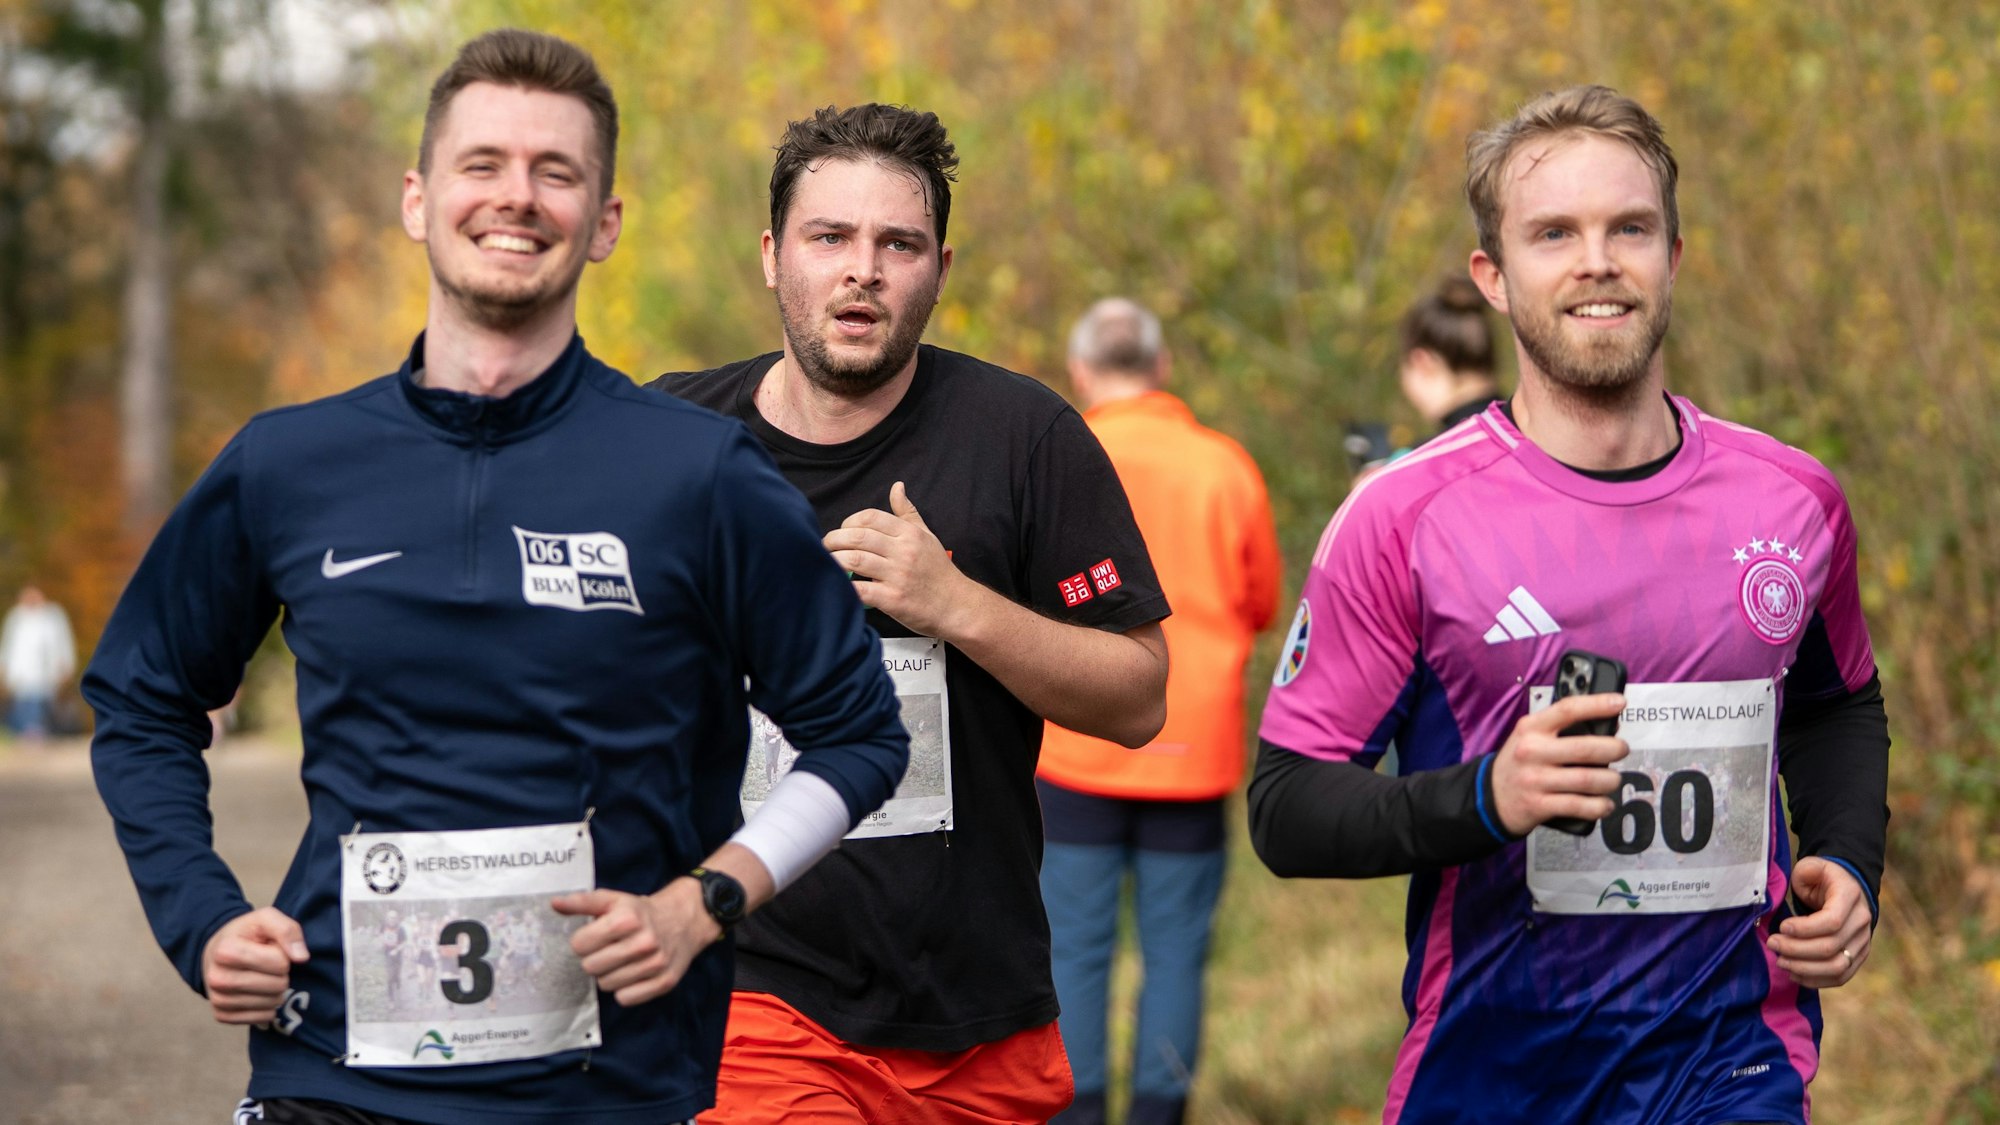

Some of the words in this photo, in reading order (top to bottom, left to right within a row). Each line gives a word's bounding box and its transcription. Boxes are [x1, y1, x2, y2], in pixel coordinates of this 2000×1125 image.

[528, 538, 565, 565] 06
[577, 542, 620, 568] SC
[1092, 563, 1112, 579] UNI
[531, 577, 575, 595] BLW
[580, 578, 632, 600] Köln
[1097, 573, 1117, 591] QLO
[883, 658, 932, 672] DLAUF
[1601, 770, 1714, 855] 60
[414, 848, 577, 872] HERBSTWALDLAUF
[1638, 880, 1711, 894] AggerEnergie
[438, 919, 495, 1005] 3
[452, 1028, 530, 1044] AggerEnergie
